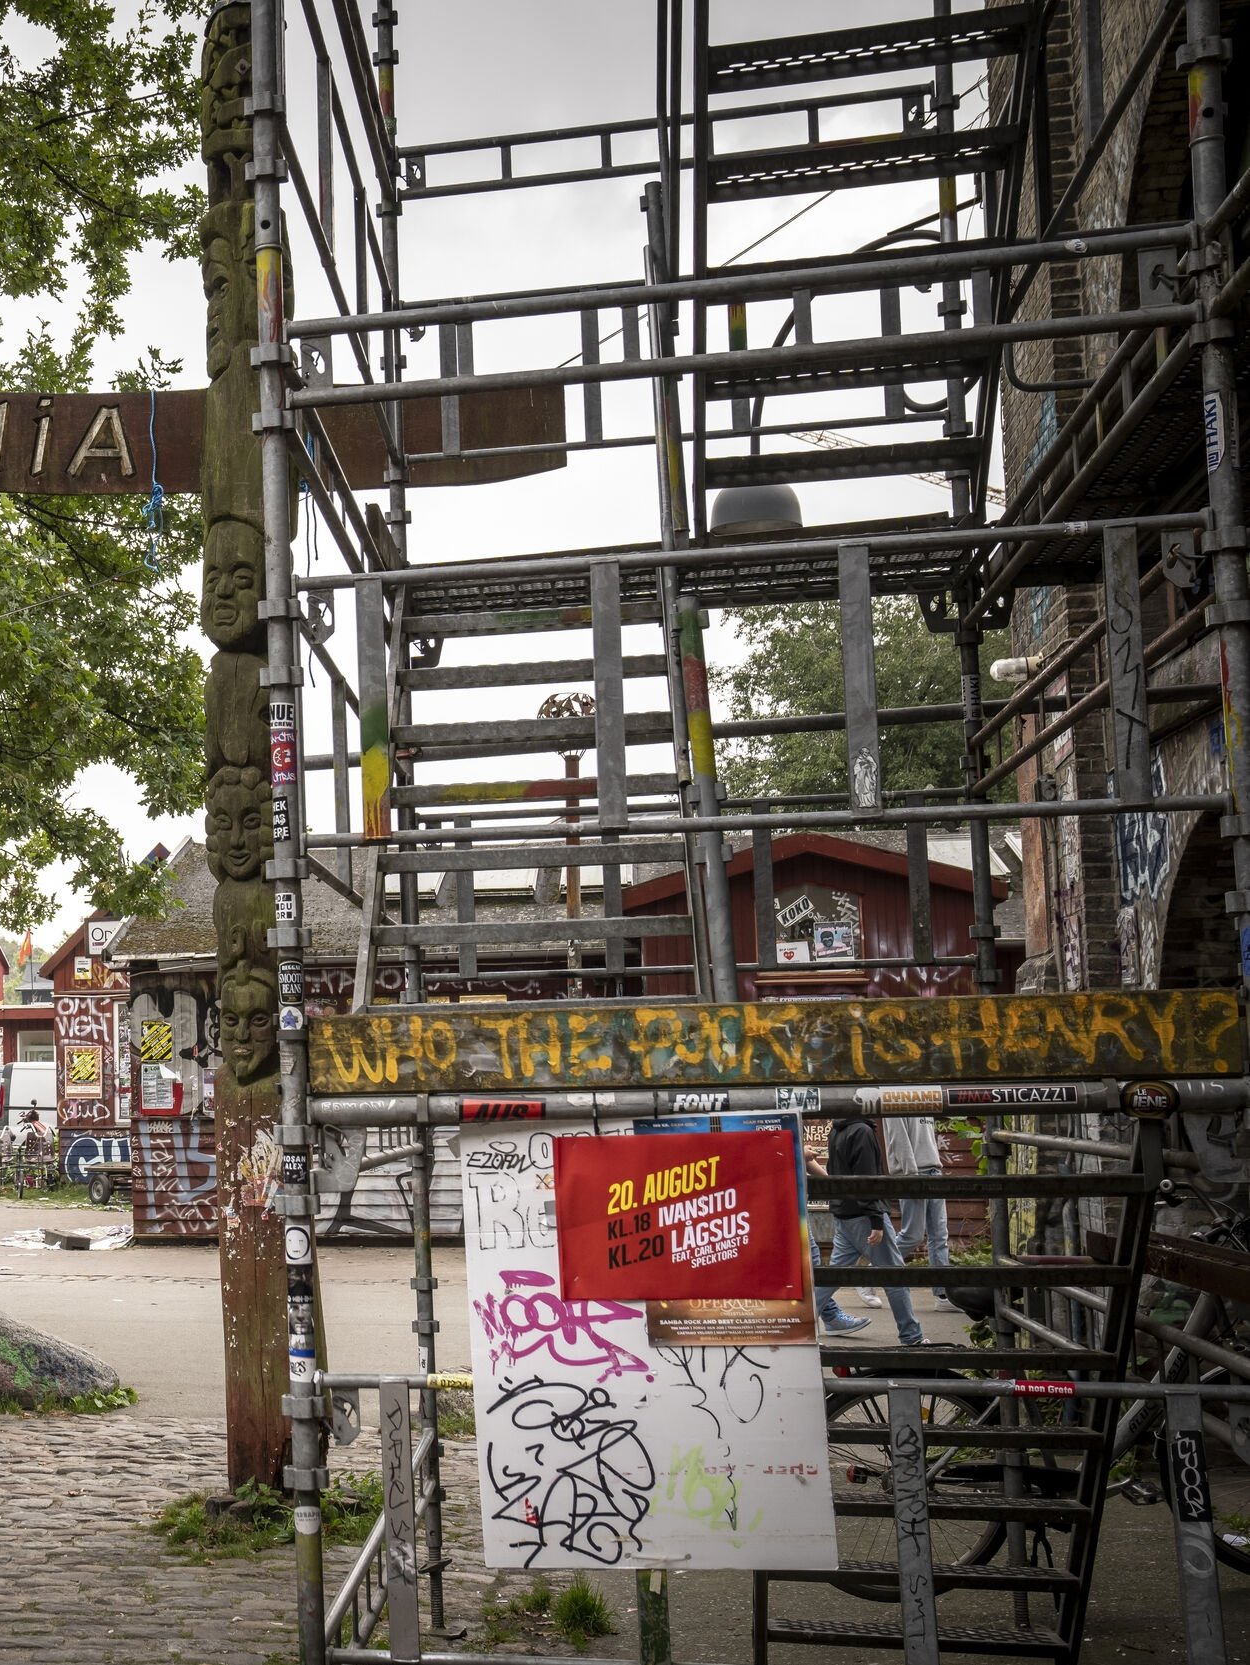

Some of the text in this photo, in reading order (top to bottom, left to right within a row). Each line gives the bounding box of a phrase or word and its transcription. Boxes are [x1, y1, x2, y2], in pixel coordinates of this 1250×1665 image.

[1205, 398, 1218, 448] HAKI
[780, 897, 811, 925] KOKO
[322, 1015, 457, 1084] WHO
[473, 1012, 613, 1079] THE
[628, 1003, 802, 1079] FUCK
[850, 1004, 921, 1078] IS
[673, 1094, 728, 1112] FONT
[882, 1089, 942, 1102] DYNAMO
[883, 1102, 942, 1112] DRESDEN
[958, 1087, 1067, 1102] #MASTICAZZI
[607, 1155, 720, 1215] 20. AUGUST
[607, 1212, 651, 1241] KL.18
[608, 1211, 750, 1270] KL.20 LÅGSUS
[671, 1235, 749, 1263] FEAT. CARL KNAST &
[691, 1249, 738, 1269] SPECKTORS
[1028, 1384, 1046, 1393] non
[1047, 1384, 1073, 1394] Grata
